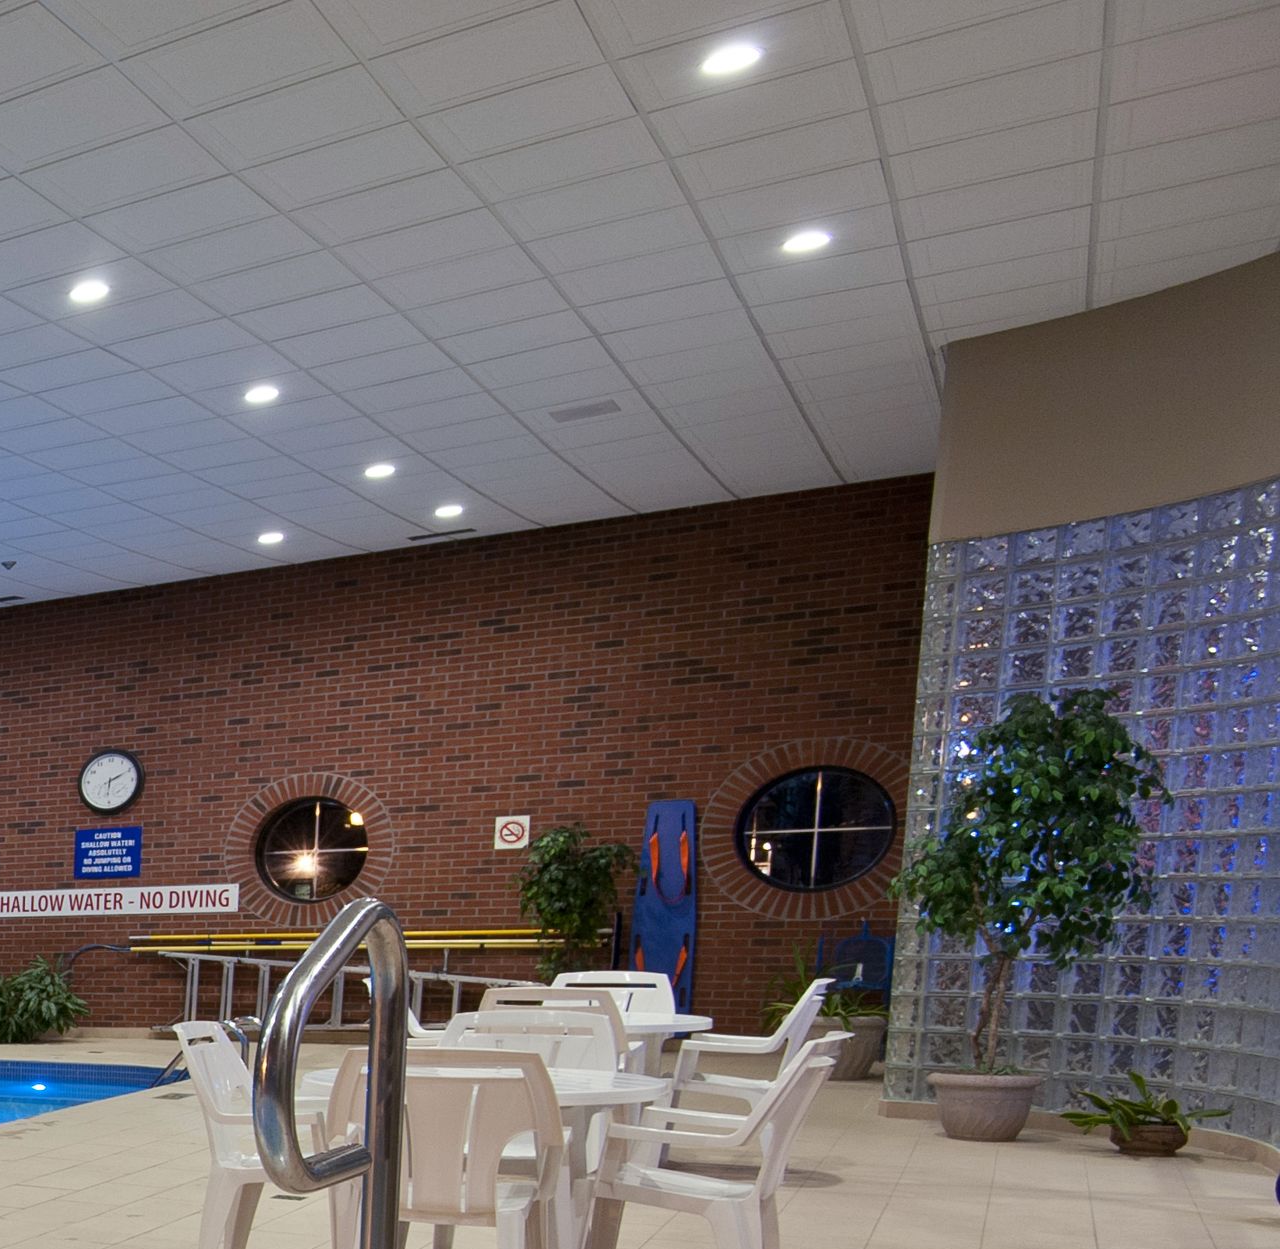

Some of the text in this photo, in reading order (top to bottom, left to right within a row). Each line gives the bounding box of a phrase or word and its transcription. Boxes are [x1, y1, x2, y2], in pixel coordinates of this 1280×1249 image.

[81, 839, 135, 849] SHALLOW WATER!
[68, 892, 123, 911] WATER
[140, 891, 164, 909] NO
[169, 889, 230, 909] DIVING
